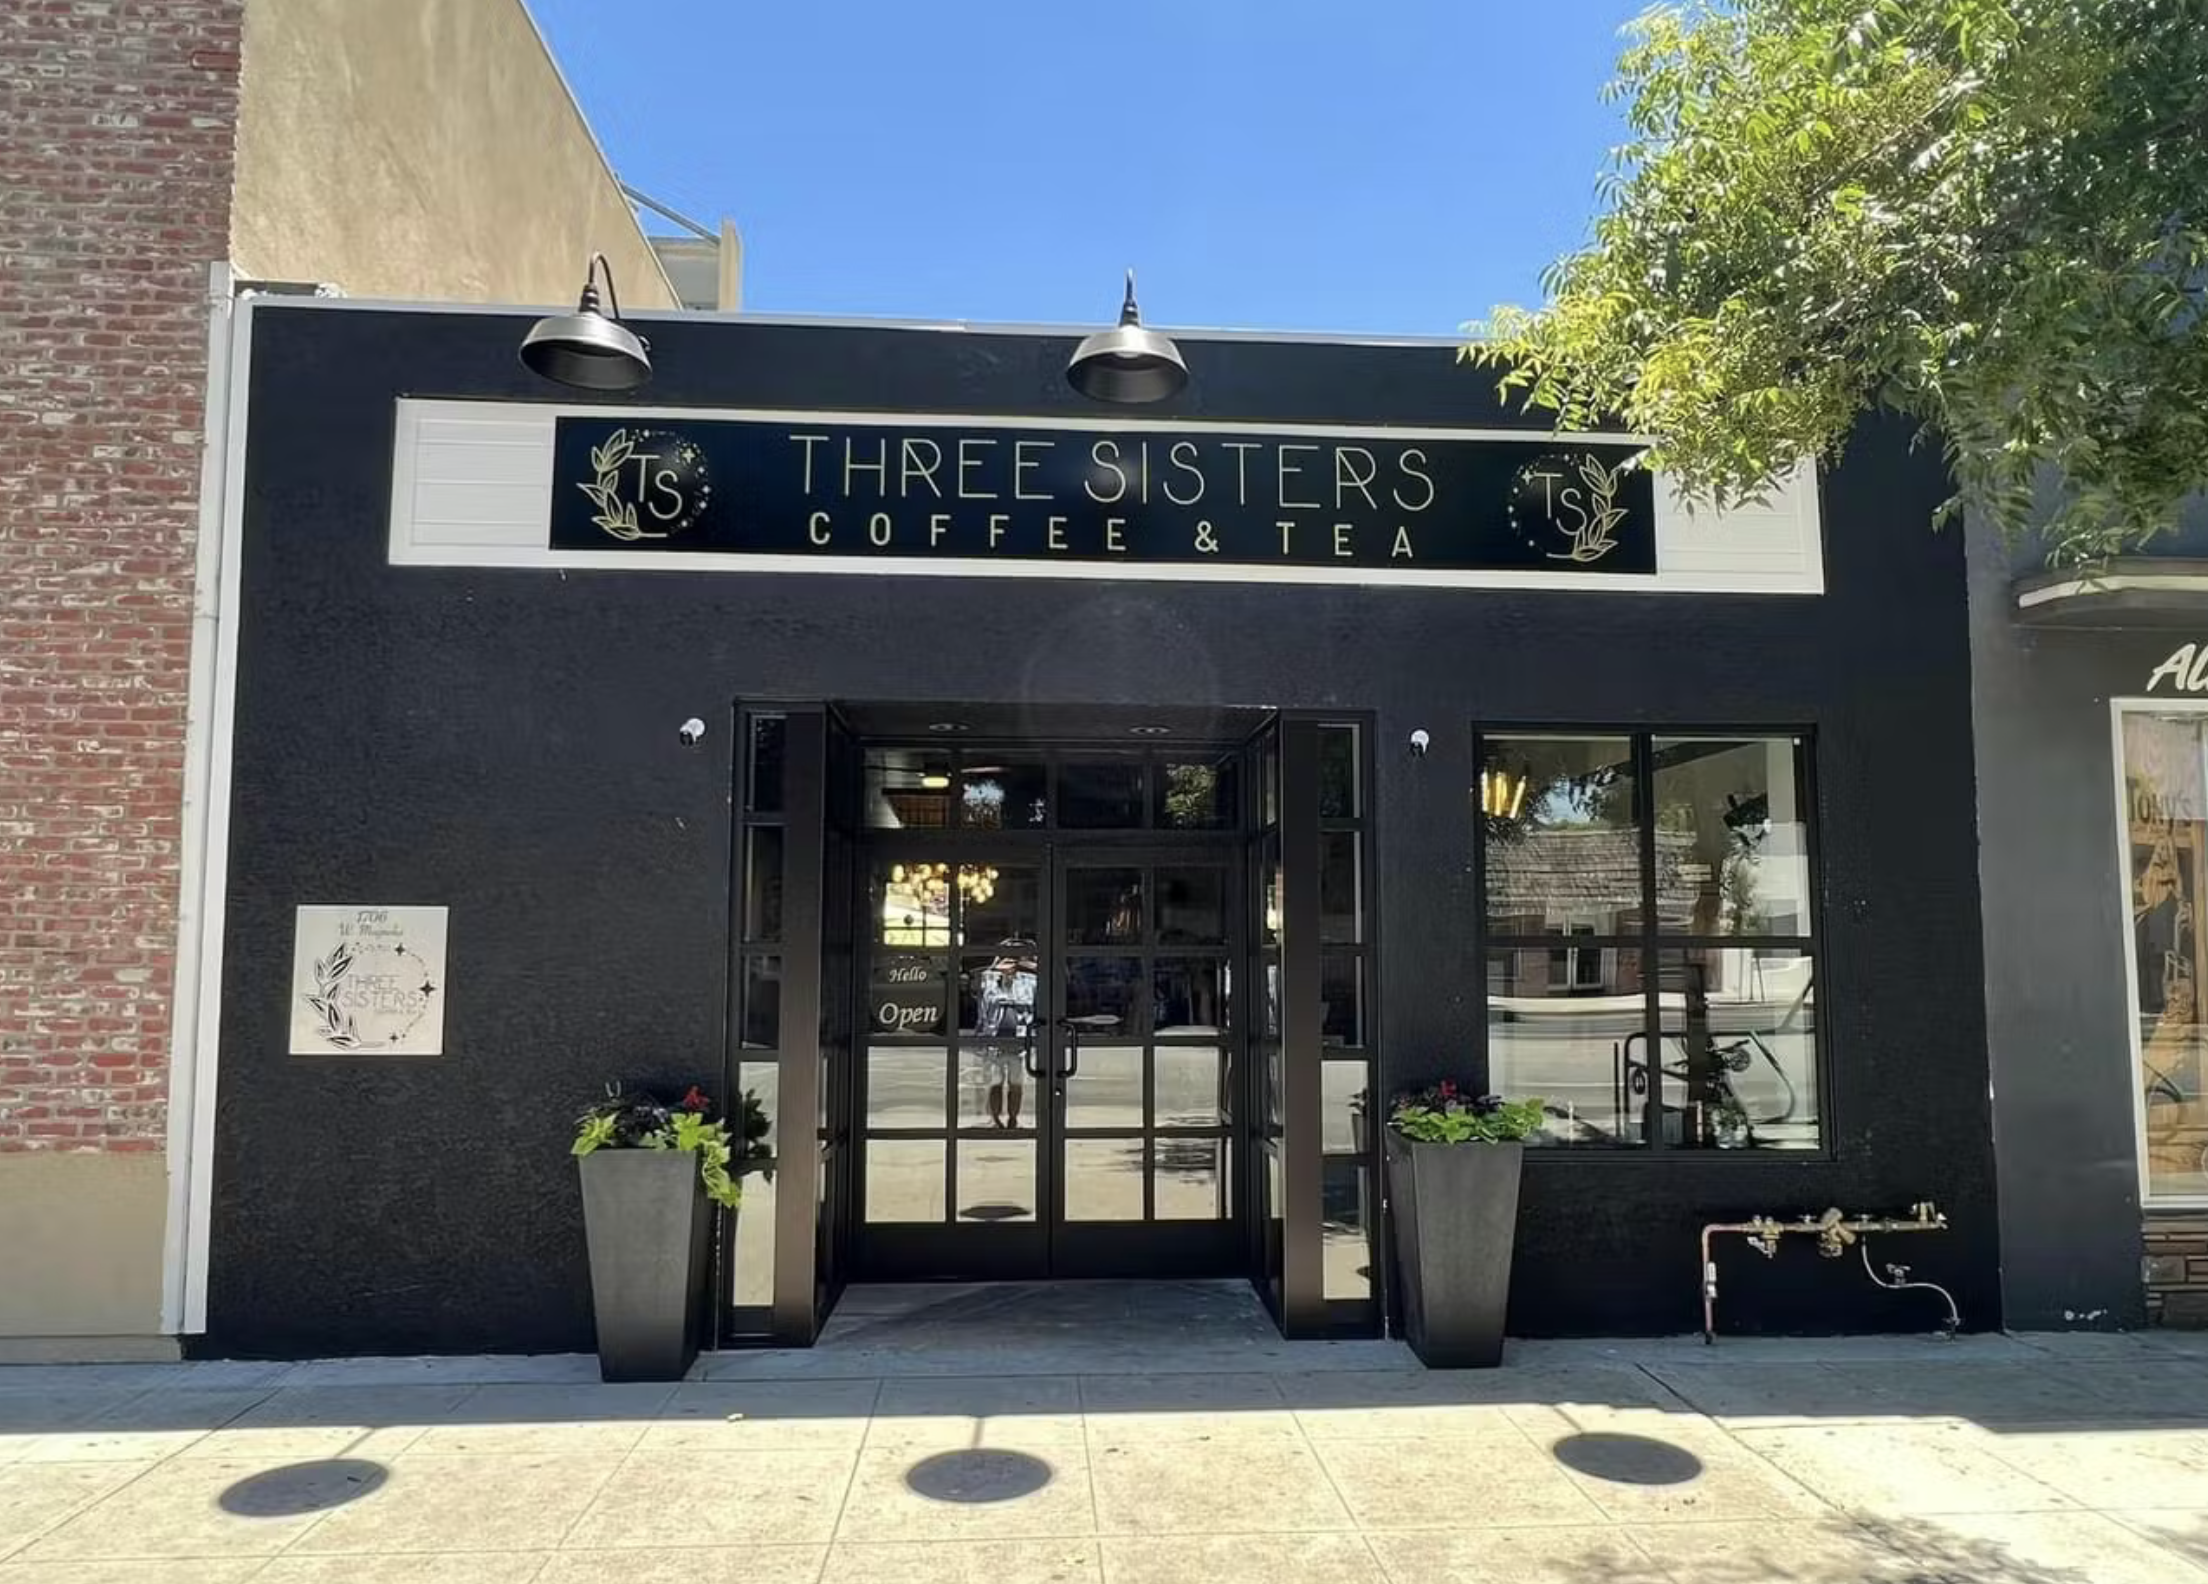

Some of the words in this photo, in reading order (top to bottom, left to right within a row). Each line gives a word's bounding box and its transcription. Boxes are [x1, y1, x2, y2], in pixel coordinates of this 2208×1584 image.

[628, 454, 683, 519] TS
[789, 435, 1056, 500] THREE
[1084, 440, 1435, 512] SISTERS
[1532, 471, 1588, 536] TS
[809, 512, 1127, 551] COFFEE
[1194, 520, 1220, 552] &
[1275, 521, 1414, 558] TEA
[889, 965, 928, 983] Hello
[341, 989, 419, 1009] SISTERS
[879, 1002, 939, 1030] Open
